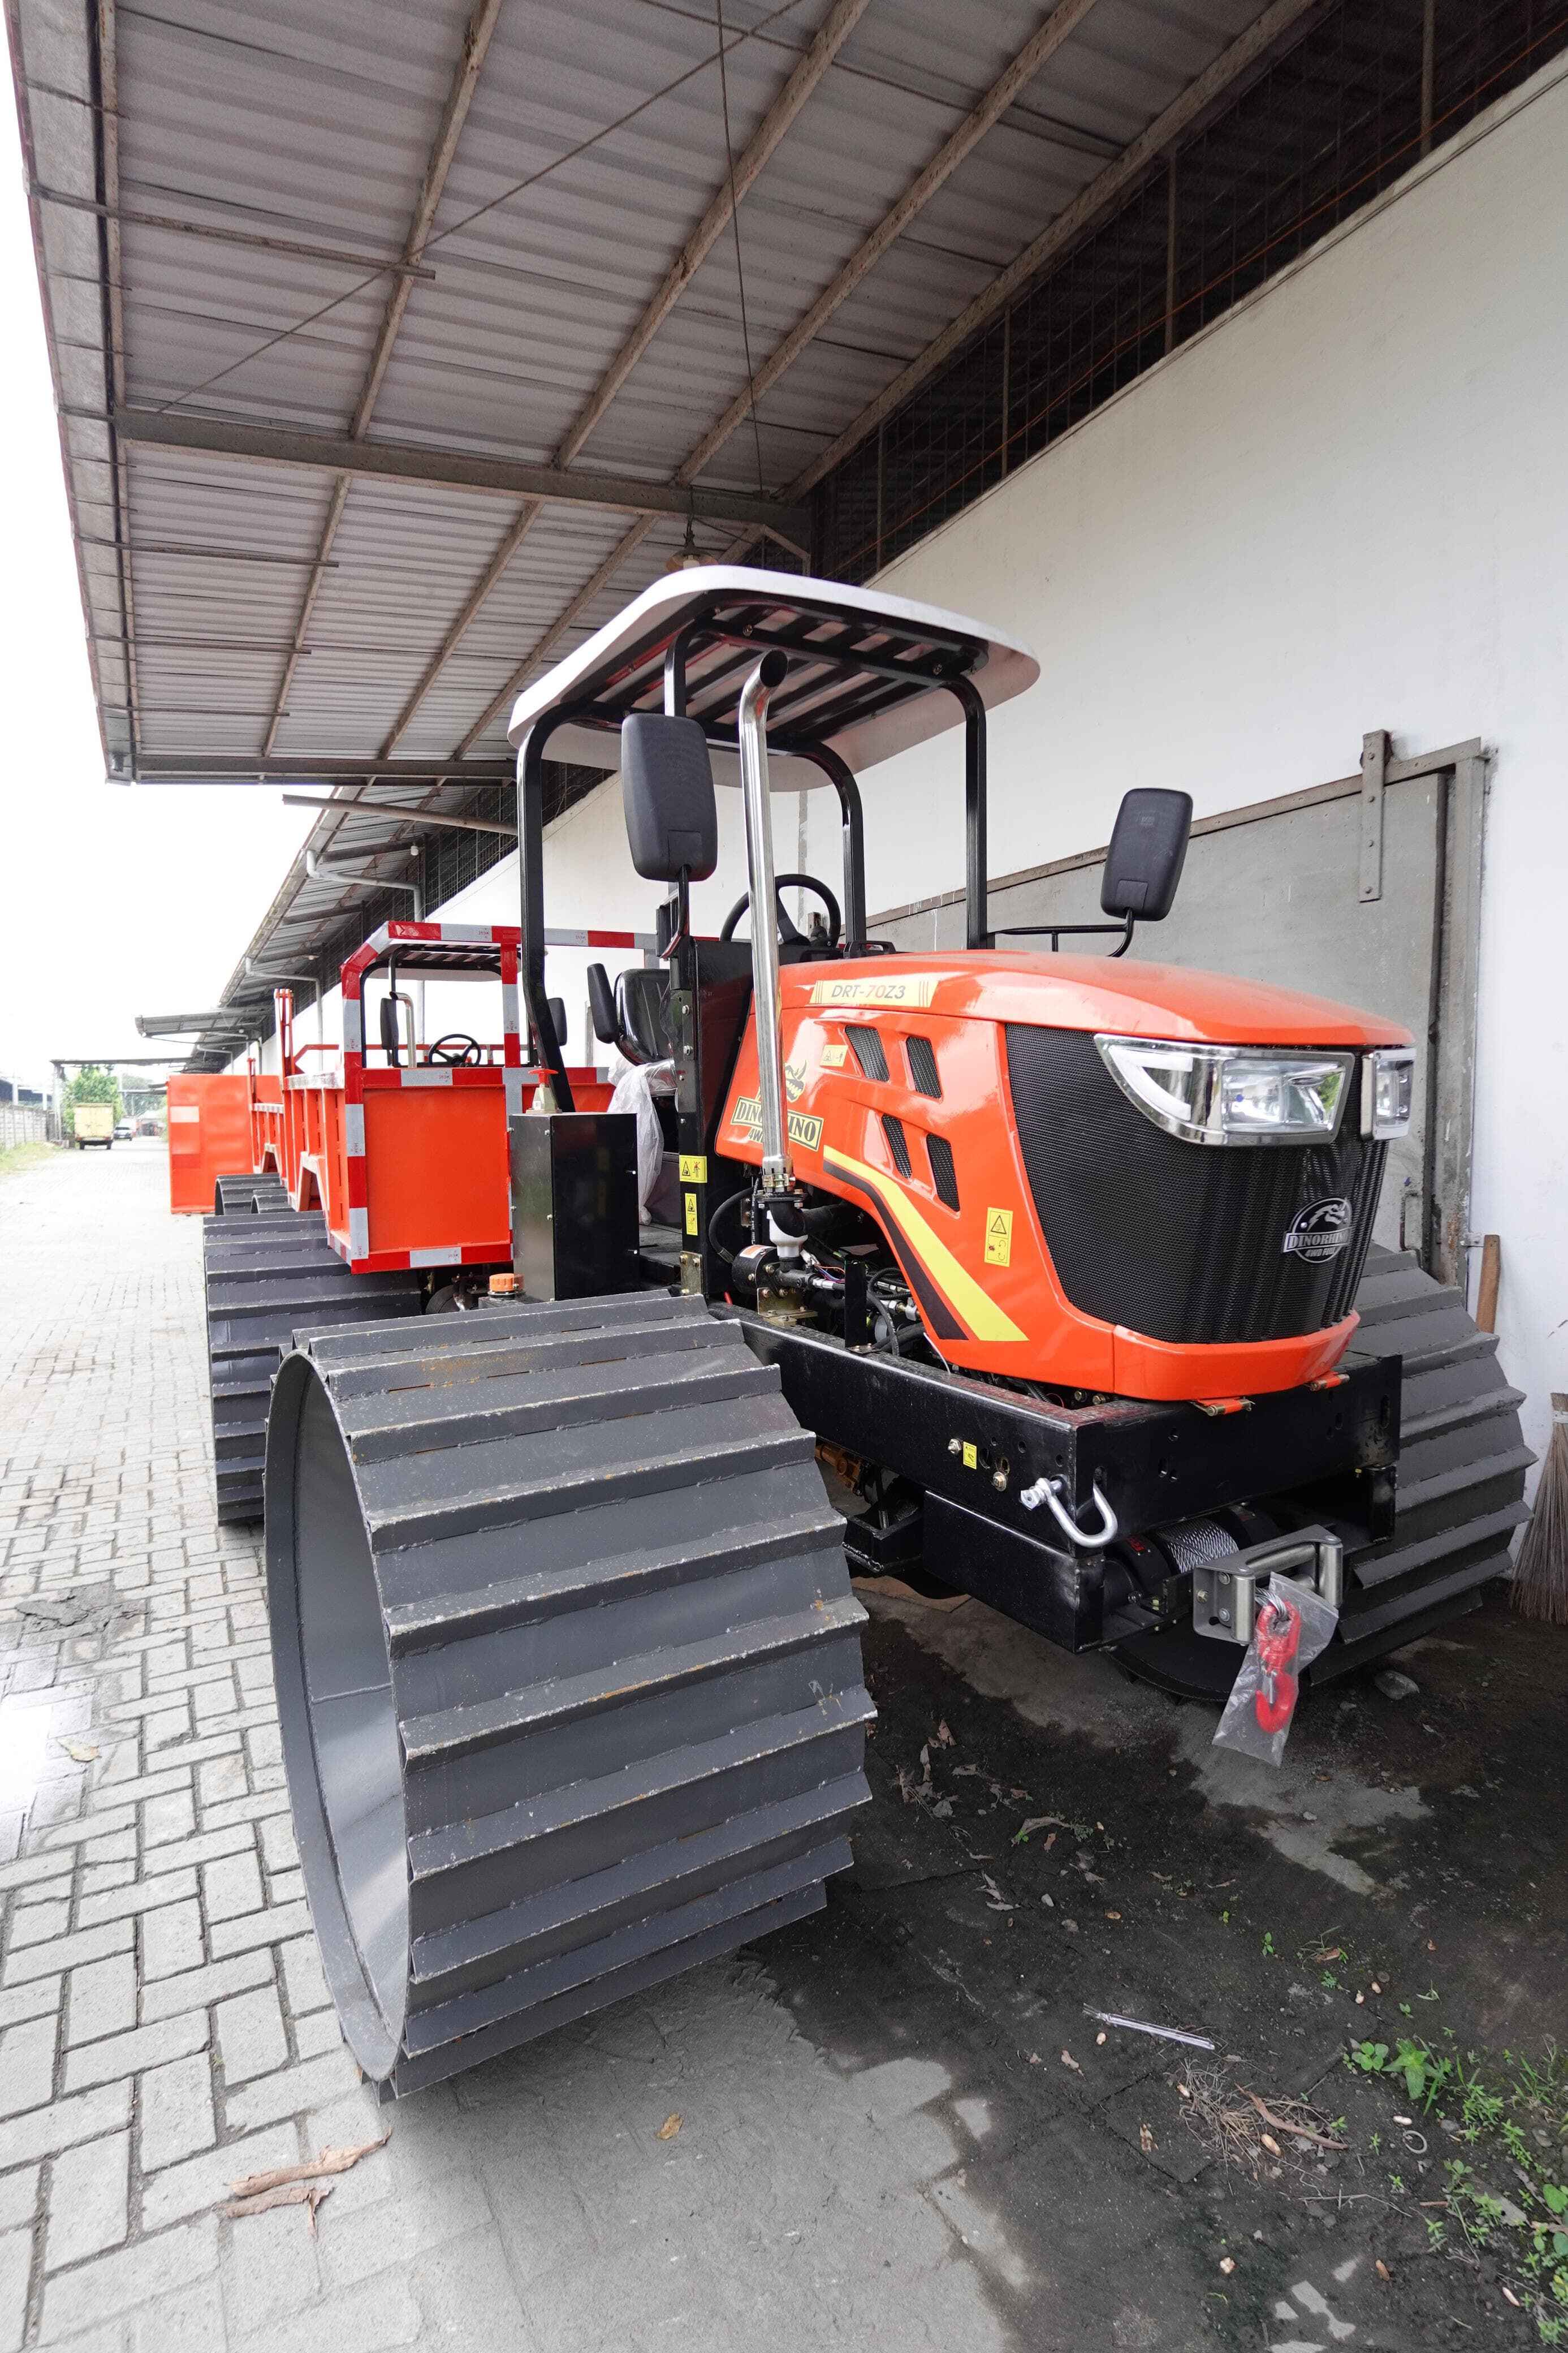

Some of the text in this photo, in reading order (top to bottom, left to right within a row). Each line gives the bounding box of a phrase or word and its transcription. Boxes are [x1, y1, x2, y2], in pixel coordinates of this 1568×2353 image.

[831, 985, 906, 999] DRT-70Z3
[736, 1101, 816, 1142] DININO
[749, 1128, 763, 1143] 4W
